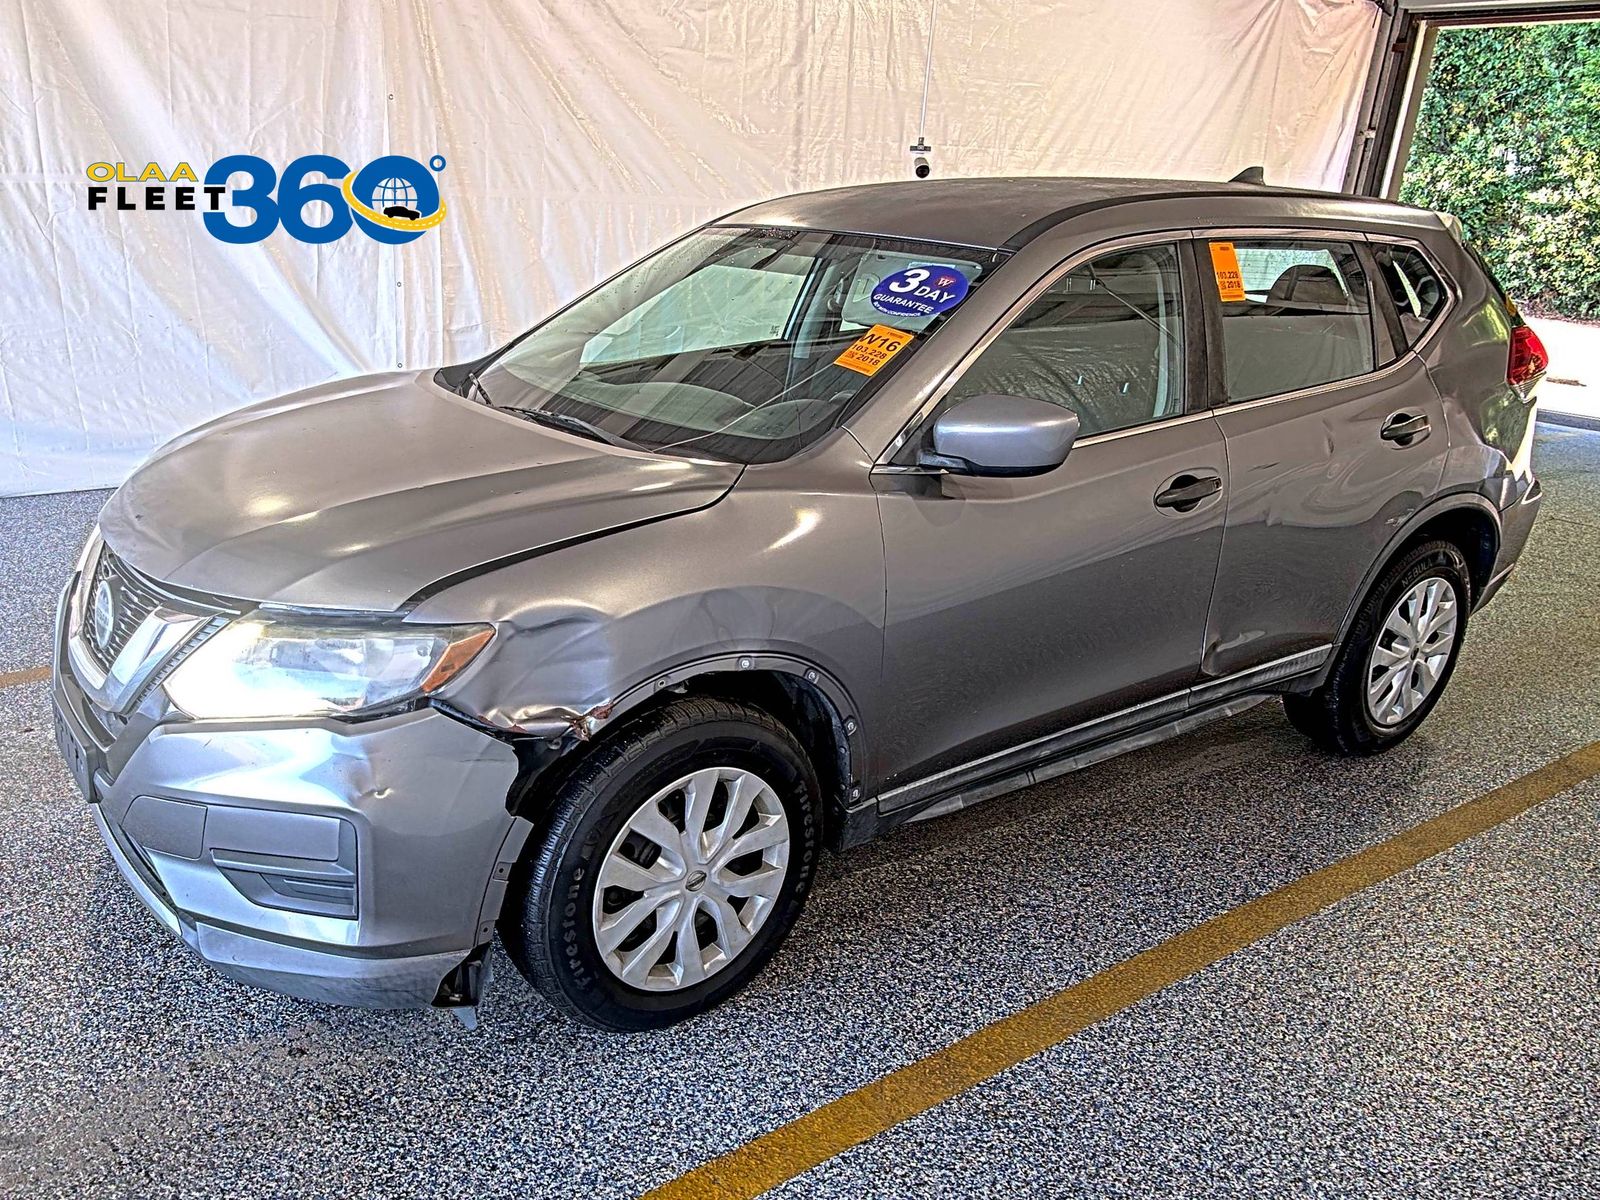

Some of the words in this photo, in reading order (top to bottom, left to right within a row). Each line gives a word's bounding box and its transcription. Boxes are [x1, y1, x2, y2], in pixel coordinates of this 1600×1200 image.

[888, 268, 930, 293] 3
[873, 293, 934, 314] GUARANTEE
[913, 286, 956, 303] DAY
[856, 353, 881, 366] 2018
